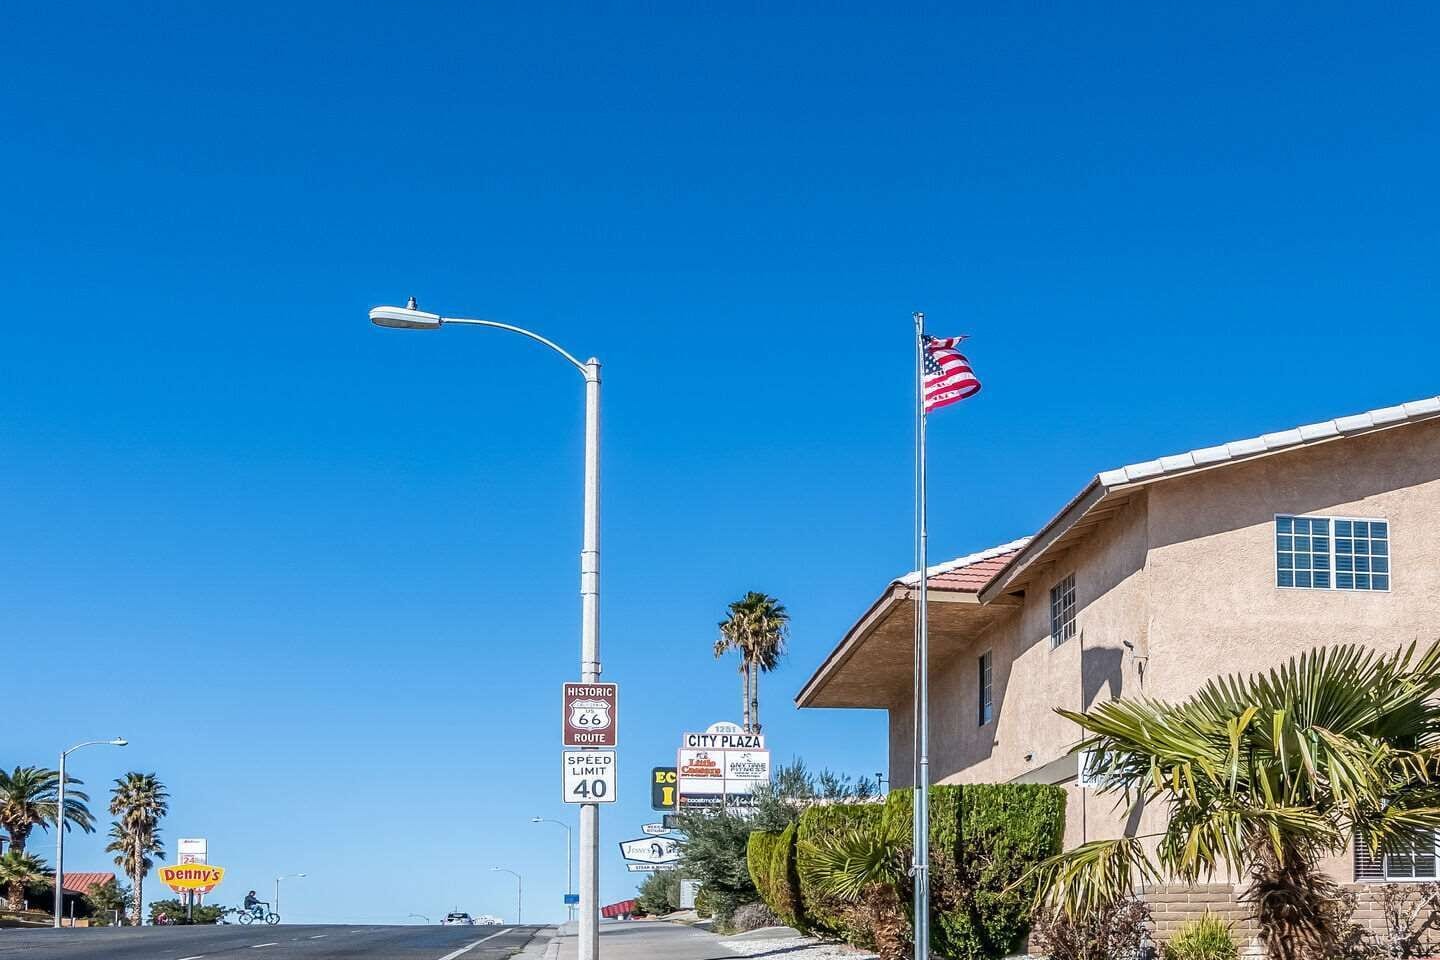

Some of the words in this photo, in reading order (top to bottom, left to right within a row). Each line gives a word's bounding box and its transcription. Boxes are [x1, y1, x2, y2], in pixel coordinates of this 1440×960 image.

[567, 687, 613, 697] HISTORIC
[578, 713, 602, 725] 66
[574, 733, 606, 743] ROUTE
[688, 734, 717, 747] CITY
[721, 735, 761, 748] PLAZA
[568, 756, 612, 765] SPEED
[572, 767, 607, 776] LIMIT
[573, 779, 607, 798] 40
[164, 869, 220, 882] Denny's
